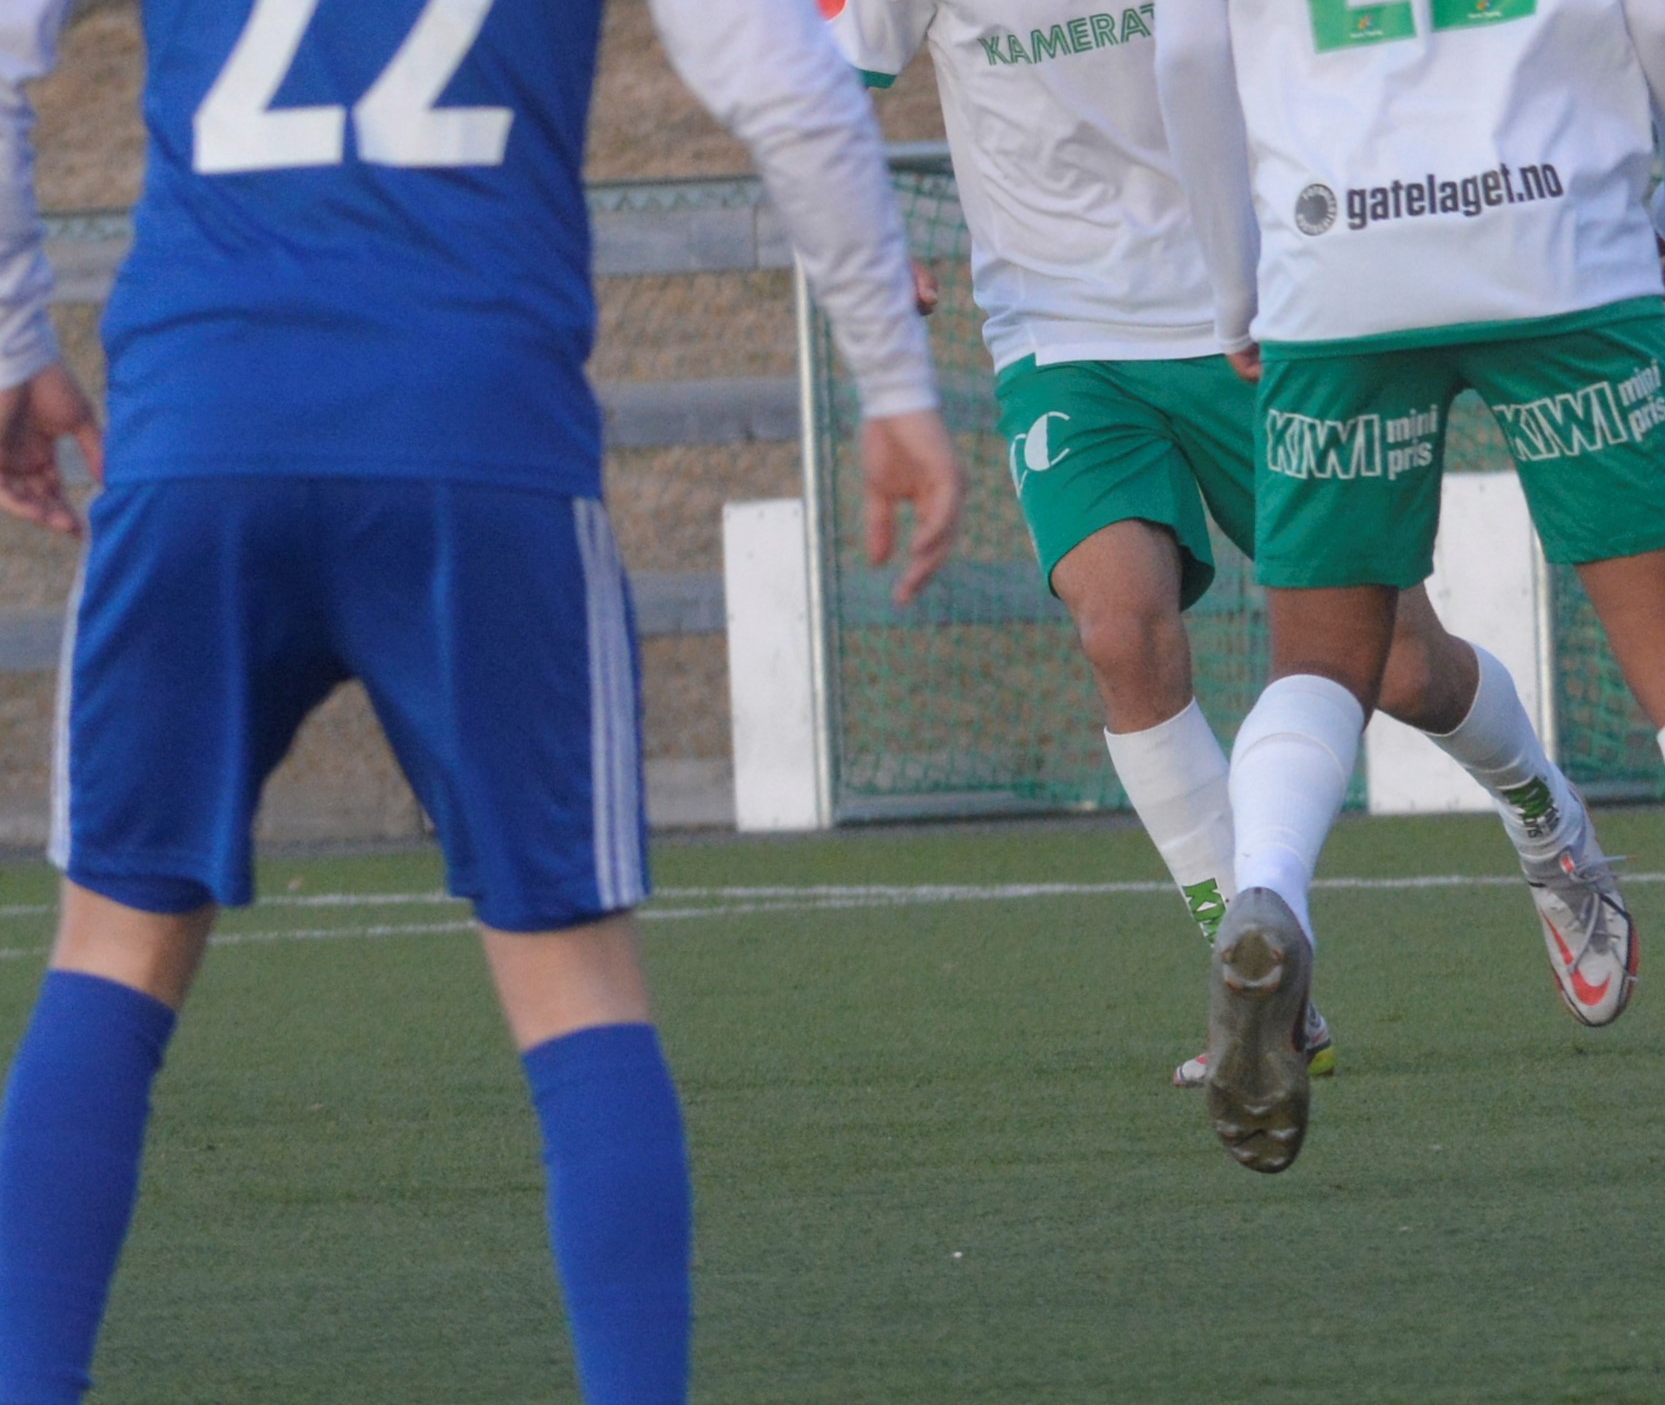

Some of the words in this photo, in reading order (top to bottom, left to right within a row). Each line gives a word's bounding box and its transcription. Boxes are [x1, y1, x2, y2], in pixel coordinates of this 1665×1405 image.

[1346, 162, 1564, 230] gatelaget.no
[1616, 358, 1661, 406] mini
[1268, 408, 1381, 480] KIWI
[1385, 404, 1437, 444] mini
[1492, 381, 1627, 462] KIWI
[1386, 442, 1433, 481] pris
